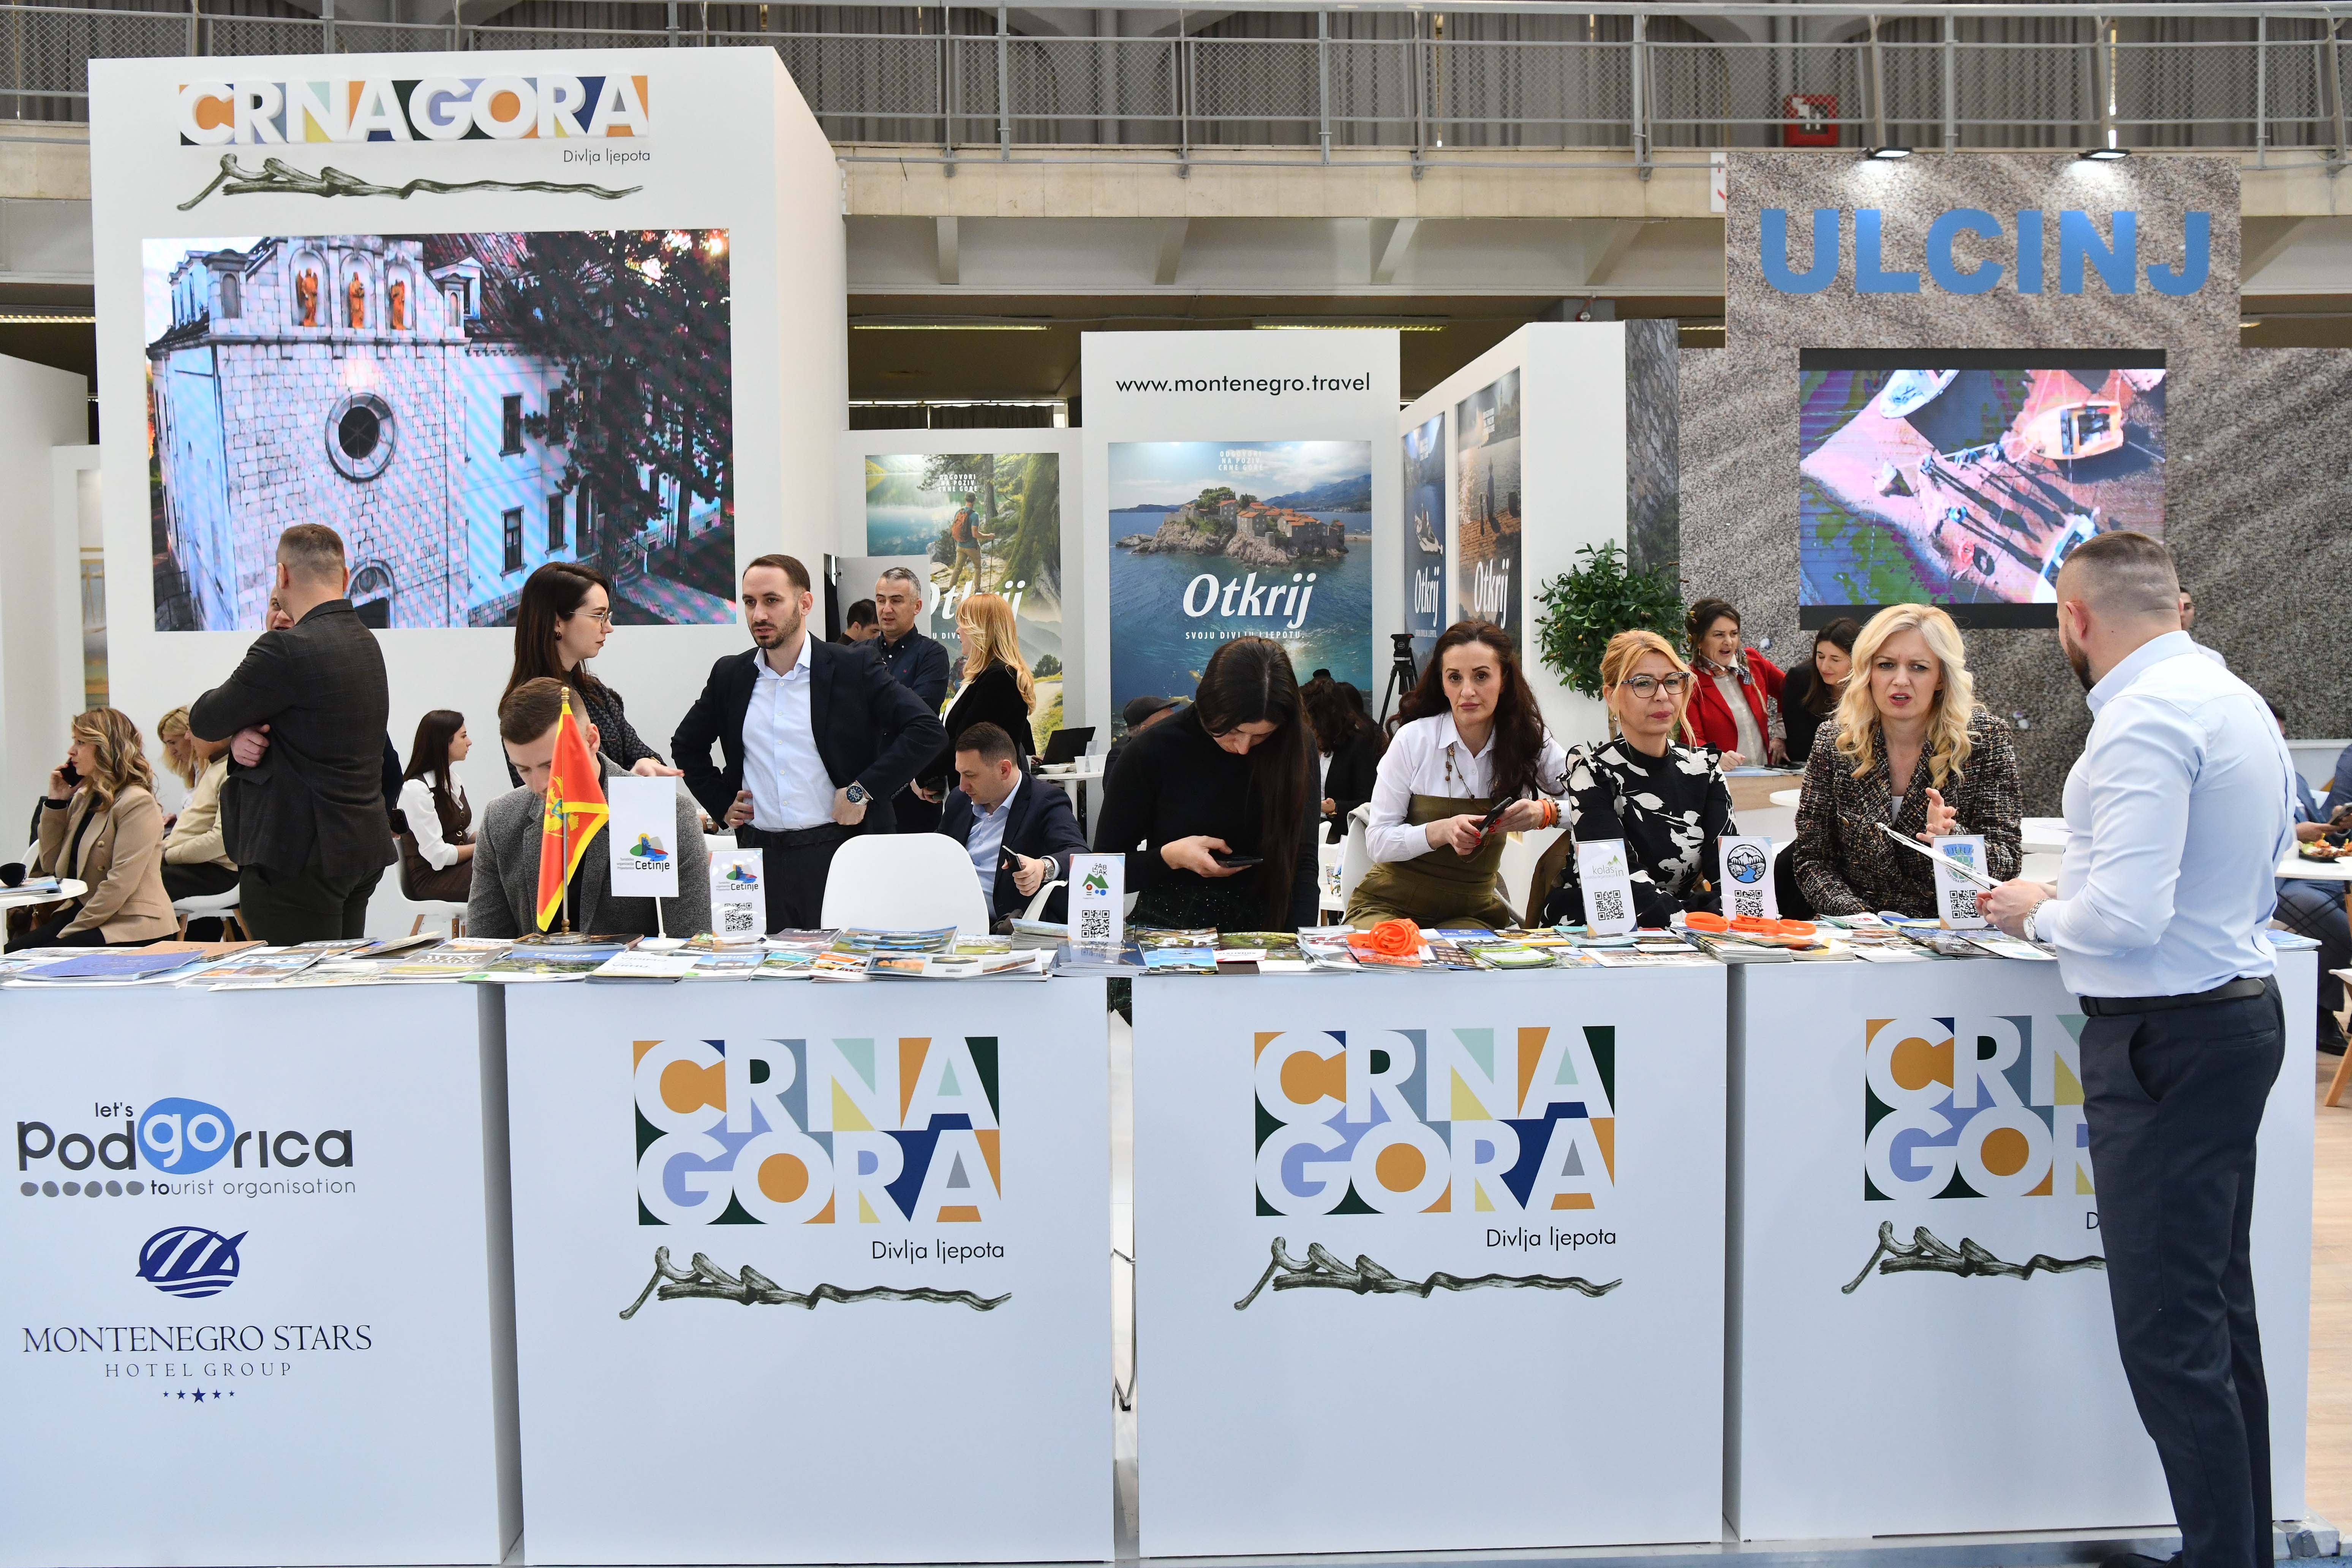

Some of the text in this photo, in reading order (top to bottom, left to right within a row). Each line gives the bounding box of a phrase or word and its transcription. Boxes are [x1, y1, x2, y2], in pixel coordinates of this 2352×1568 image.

[564, 149, 651, 164] Divlja ljepota
[1760, 208, 2210, 295] ULCINJ
[1116, 372, 1370, 395] www.montenegro.travel
[1182, 572, 1316, 629] Otkrij
[1415, 567, 1440, 628] Otkrij
[1474, 559, 1509, 629] Otkrij
[635, 861, 670, 872] Cetinje
[633, 1036, 1000, 1133] CRNA
[1254, 1026, 1615, 1124] CRNA
[1866, 1015, 2084, 1110] CRN
[95, 1101, 134, 1118] let's
[636, 1130, 1002, 1225] GORA
[1255, 1118, 1615, 1216] GORA
[1865, 1105, 2095, 1200] GOR
[151, 1178, 356, 1198] tourist organisation
[872, 1239, 1005, 1264] Divlja ljepota
[1486, 1226, 1617, 1252] Divlja ljepota
[22, 1324, 373, 1353] MONTENEGRO STARS
[105, 1363, 291, 1378] HOTEL GROUP
